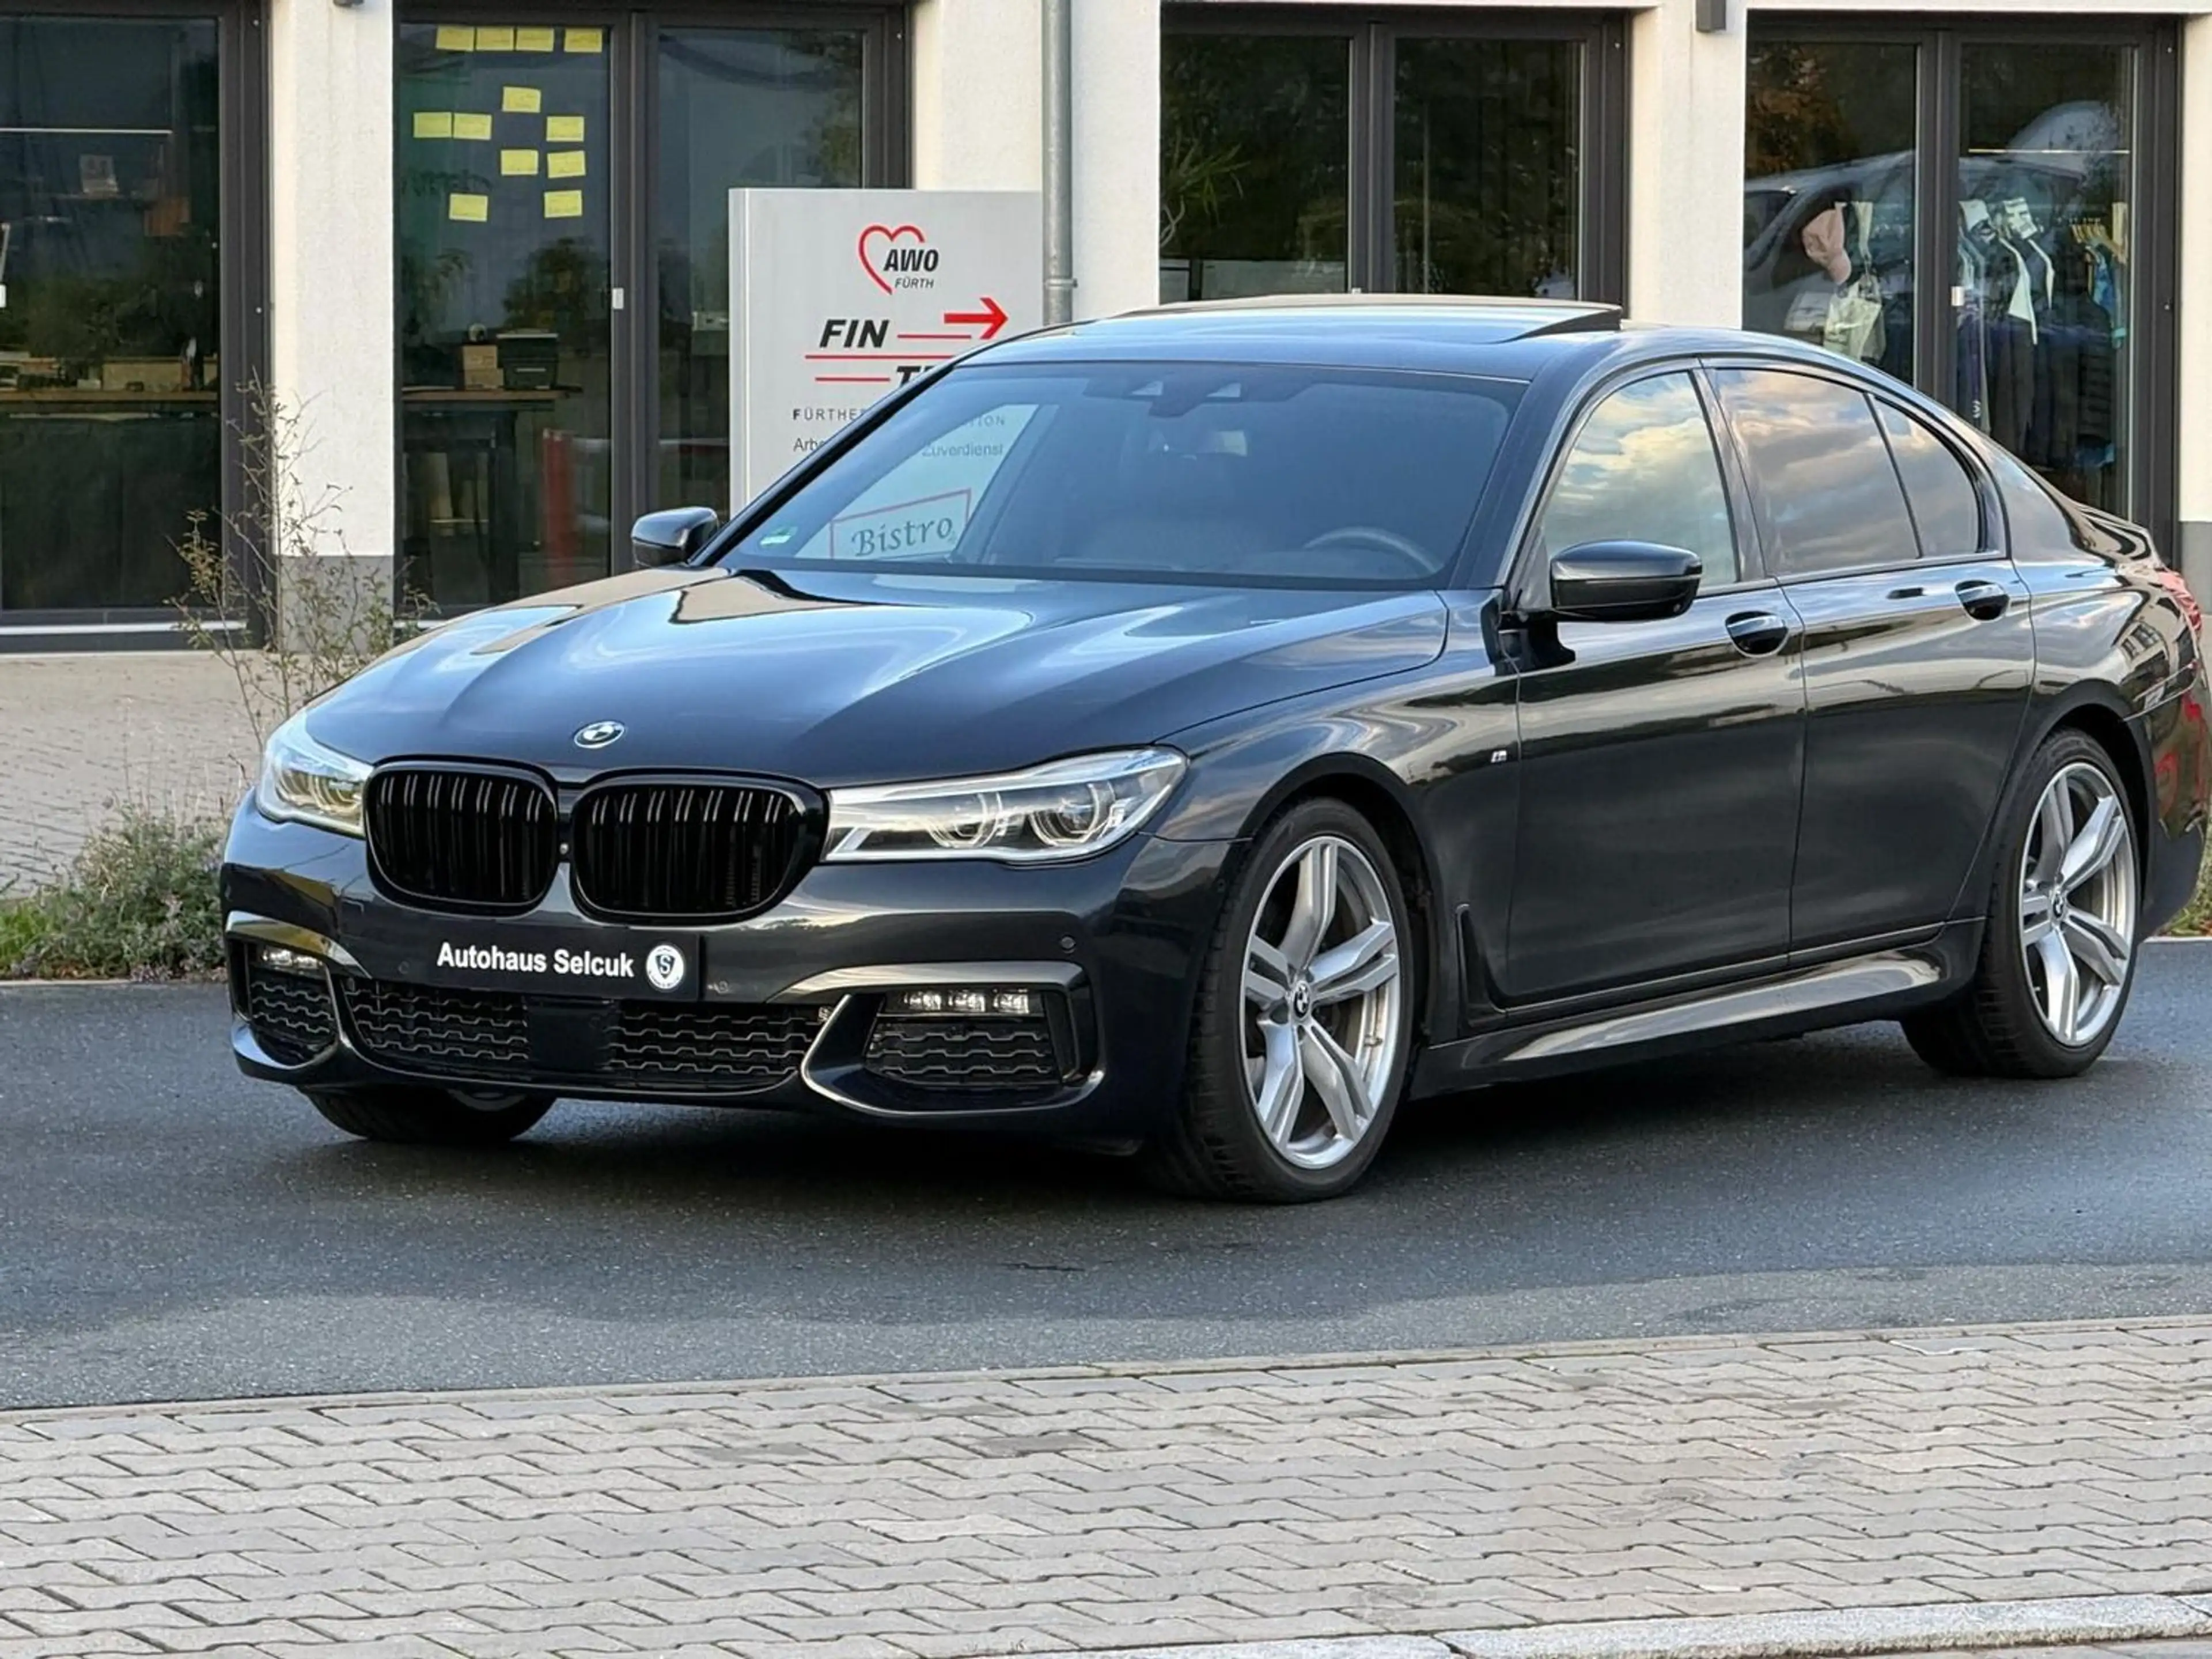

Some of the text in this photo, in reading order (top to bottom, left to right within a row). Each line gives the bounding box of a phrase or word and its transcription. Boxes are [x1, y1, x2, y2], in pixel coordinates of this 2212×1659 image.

[883, 248, 939, 272] AWO
[895, 276, 934, 289] FÜRTH
[819, 319, 890, 349] FIN
[896, 365, 934, 388] T
[793, 407, 866, 421] FÜRTHE
[851, 517, 953, 557] Bistro
[436, 941, 547, 973] Autohaus
[552, 949, 634, 978] Selcuk
